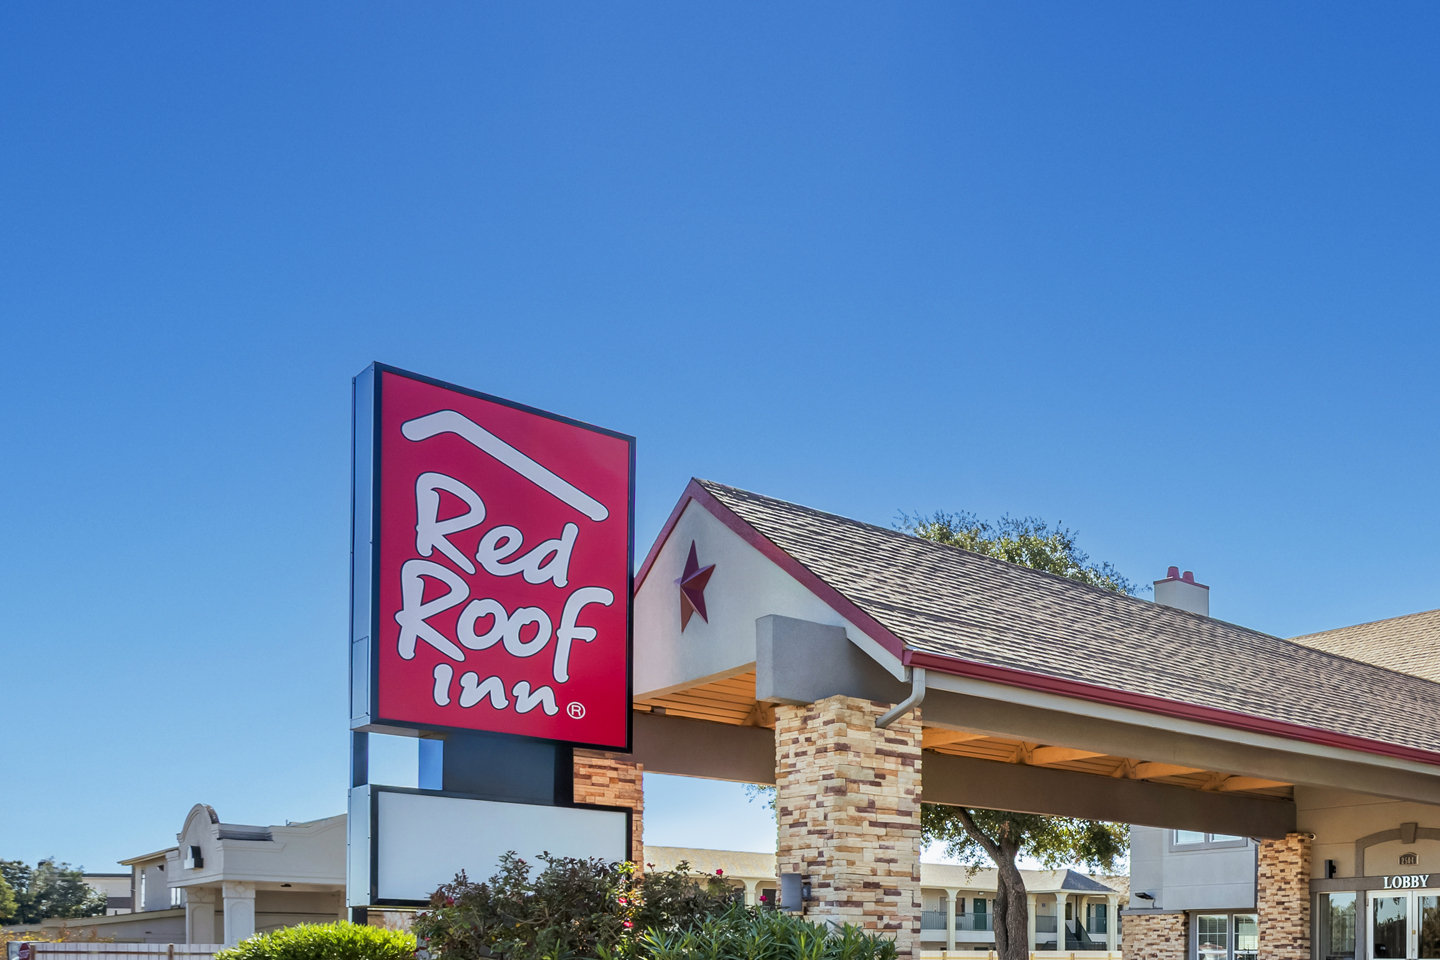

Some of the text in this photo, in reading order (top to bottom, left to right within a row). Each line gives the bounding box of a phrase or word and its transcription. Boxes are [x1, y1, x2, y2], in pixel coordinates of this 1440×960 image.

[415, 472, 579, 588] Red
[394, 559, 615, 684] Roof
[1383, 874, 1430, 889] LOBBY
